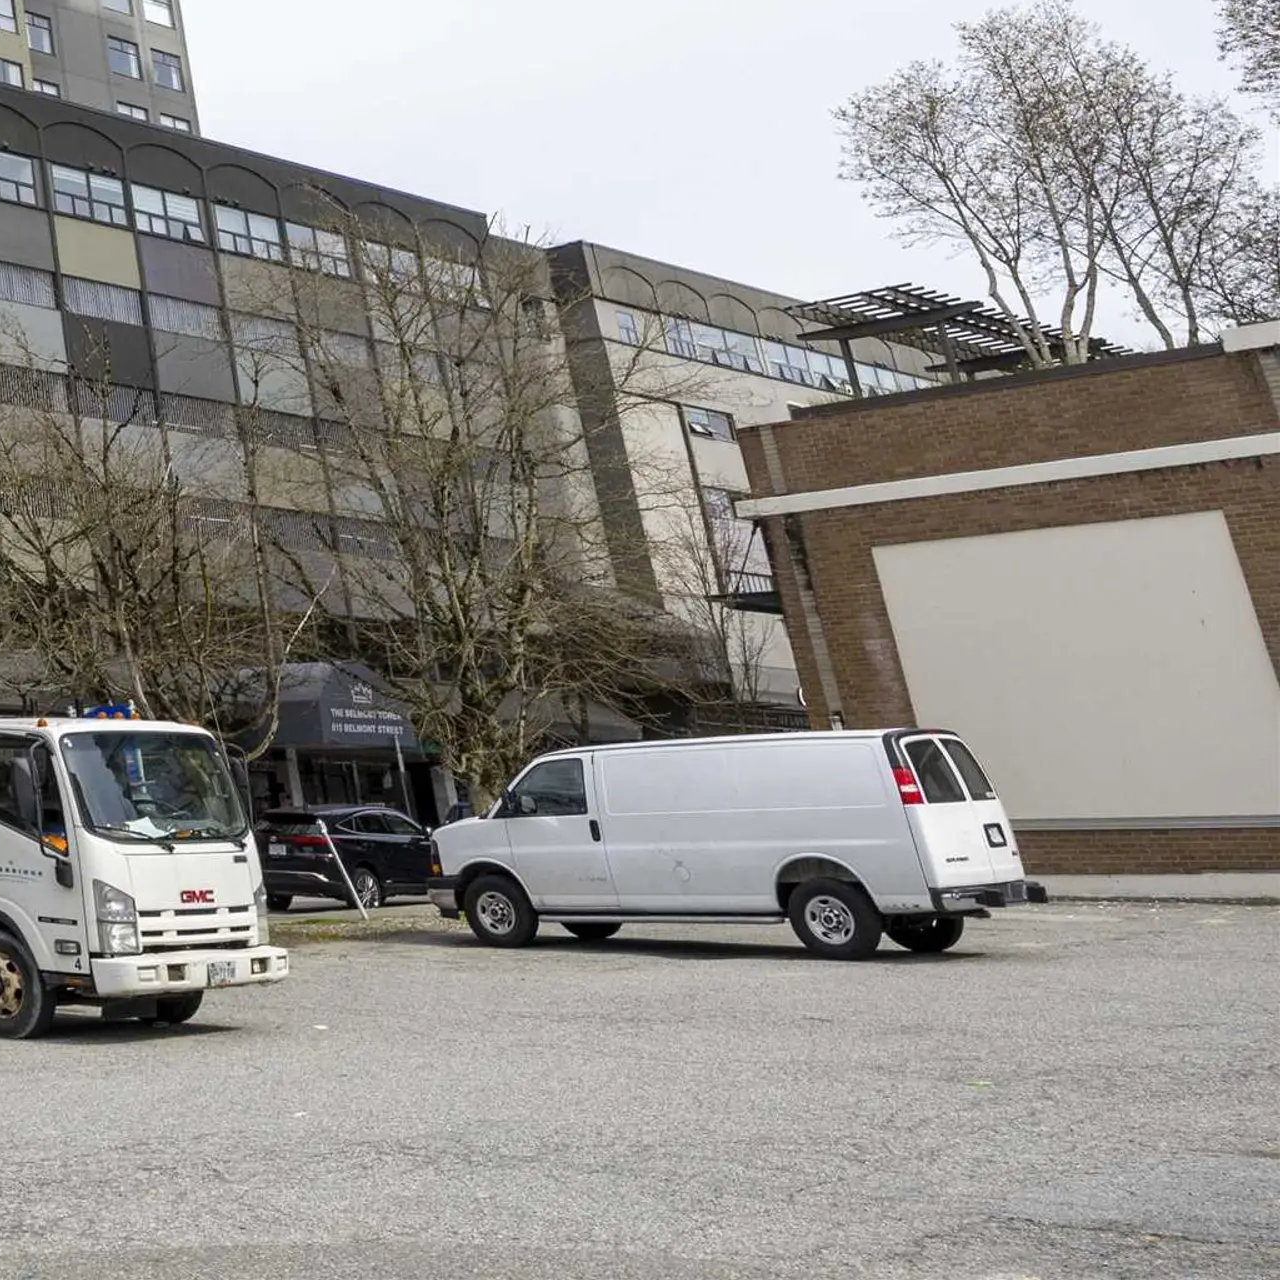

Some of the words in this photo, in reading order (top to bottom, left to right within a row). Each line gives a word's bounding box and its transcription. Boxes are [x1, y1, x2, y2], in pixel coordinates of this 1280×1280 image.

[330, 708, 343, 718] THE
[345, 709, 376, 719] BELMONT
[344, 723, 376, 734] BELMONT
[378, 725, 404, 736] STREET
[180, 890, 215, 904] GMC
[74, 958, 82, 971] 4
